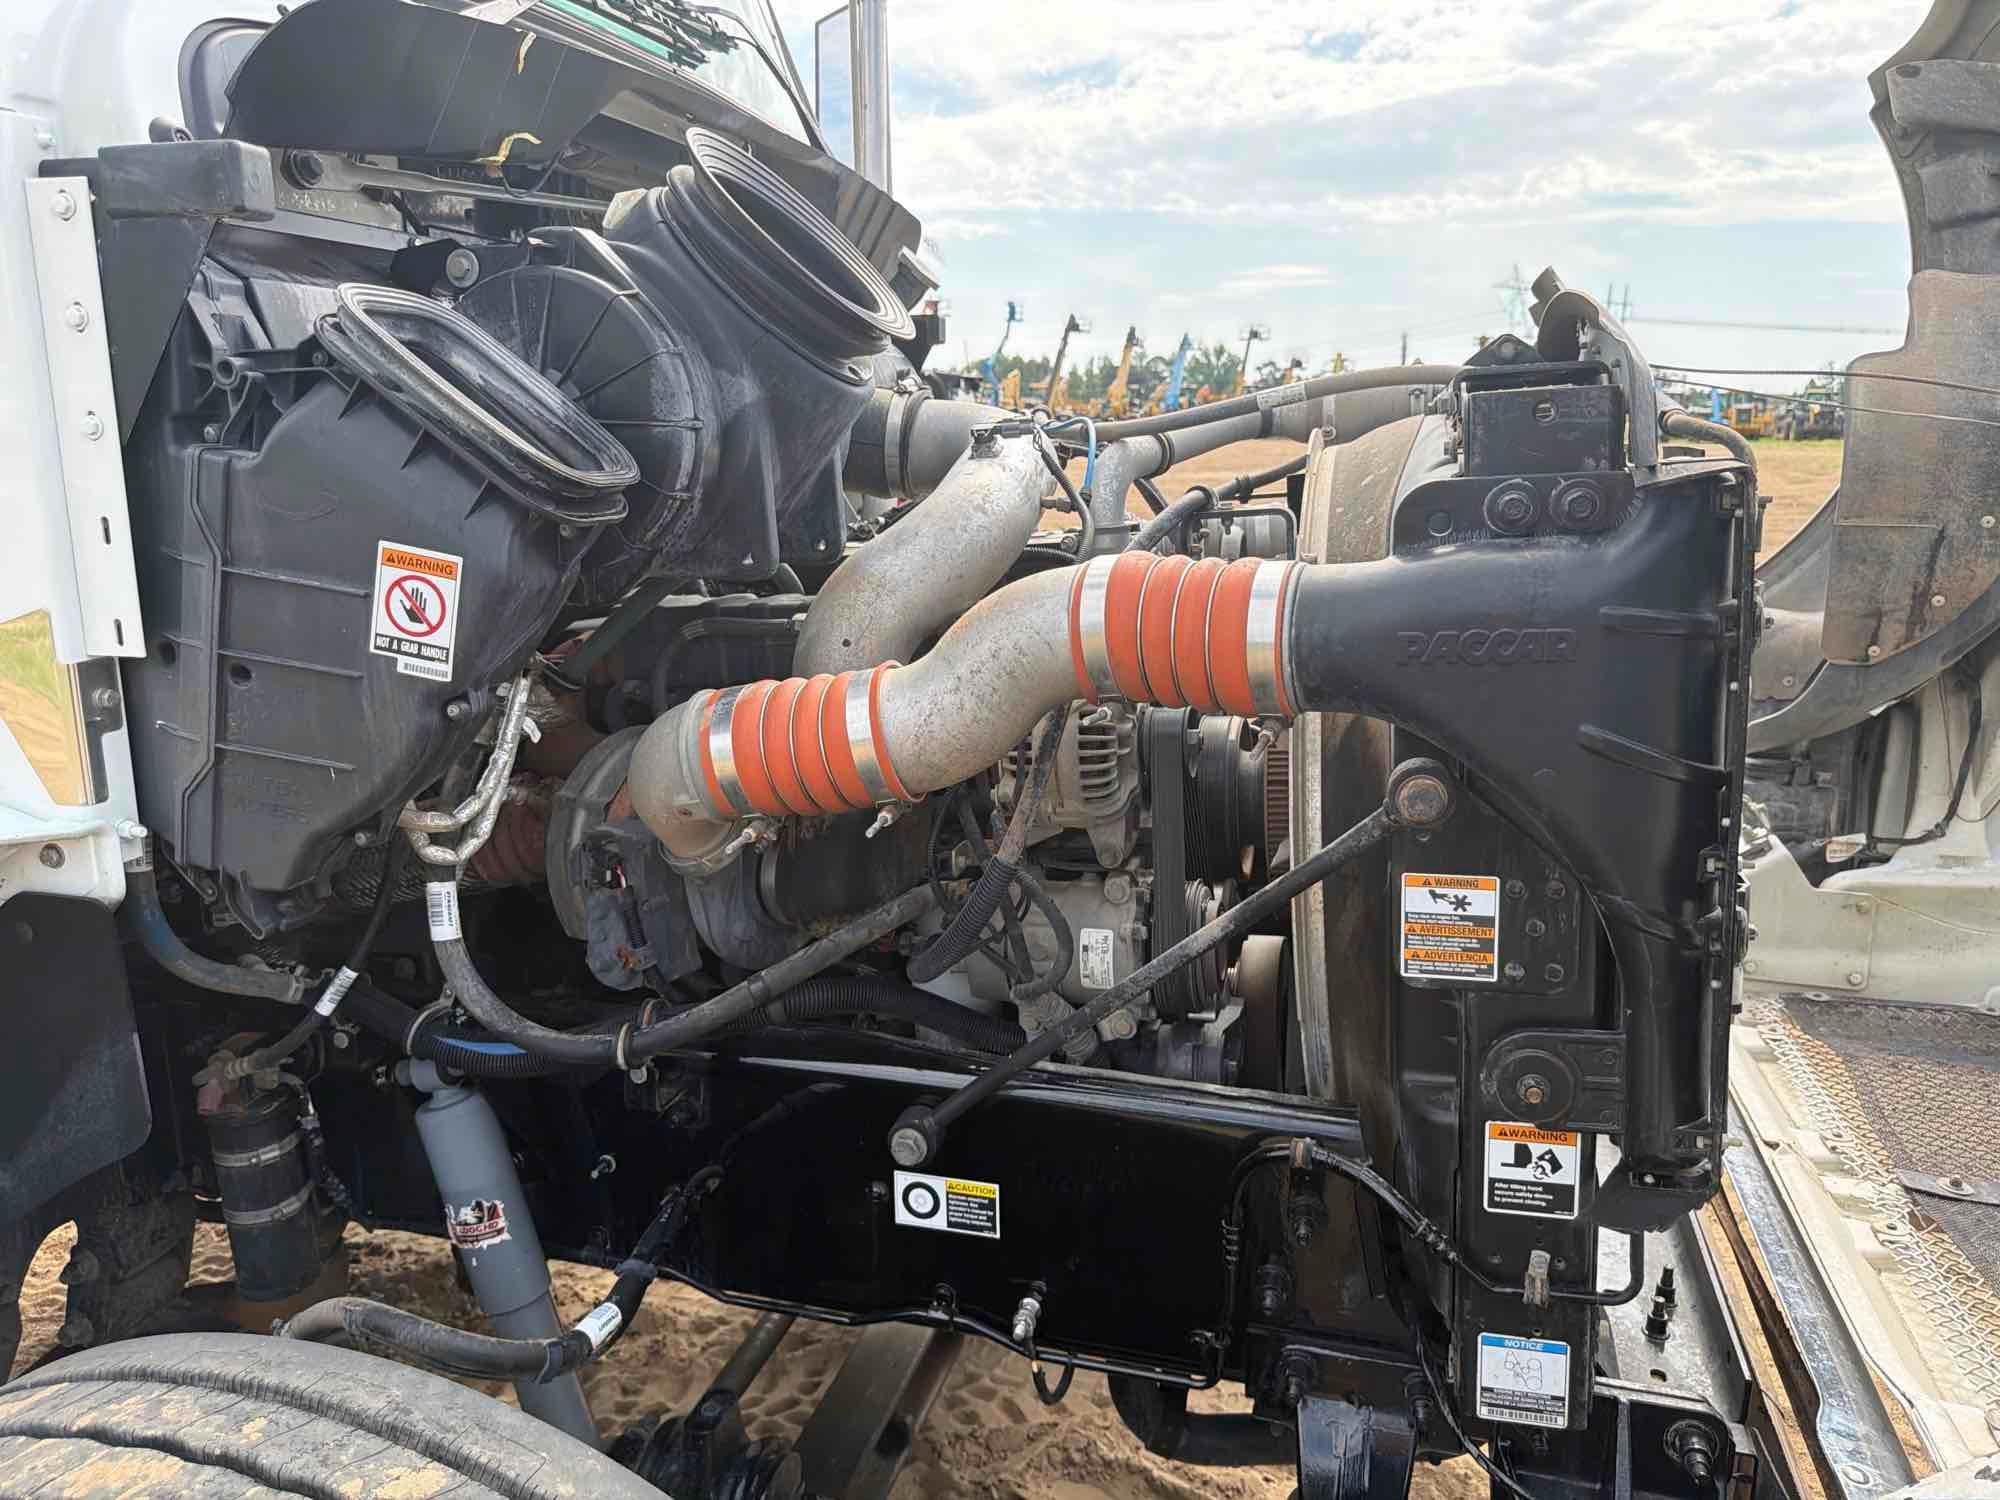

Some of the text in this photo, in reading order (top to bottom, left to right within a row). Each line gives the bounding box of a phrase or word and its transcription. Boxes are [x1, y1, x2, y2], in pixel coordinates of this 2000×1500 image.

[397, 554, 453, 575] WARNING
[376, 635, 447, 660] NOT A GRAB HANDLE
[1396, 628, 1577, 666] PACCAR
[1434, 877, 1479, 888] WARNING
[1420, 925, 1492, 936] AVERTISSEMENT
[1424, 951, 1488, 963] ADVERTENCIA
[1509, 1127, 1567, 1142] WARNING
[956, 1184, 996, 1195] CAUTION
[1504, 1340, 1544, 1351] NOTICE
